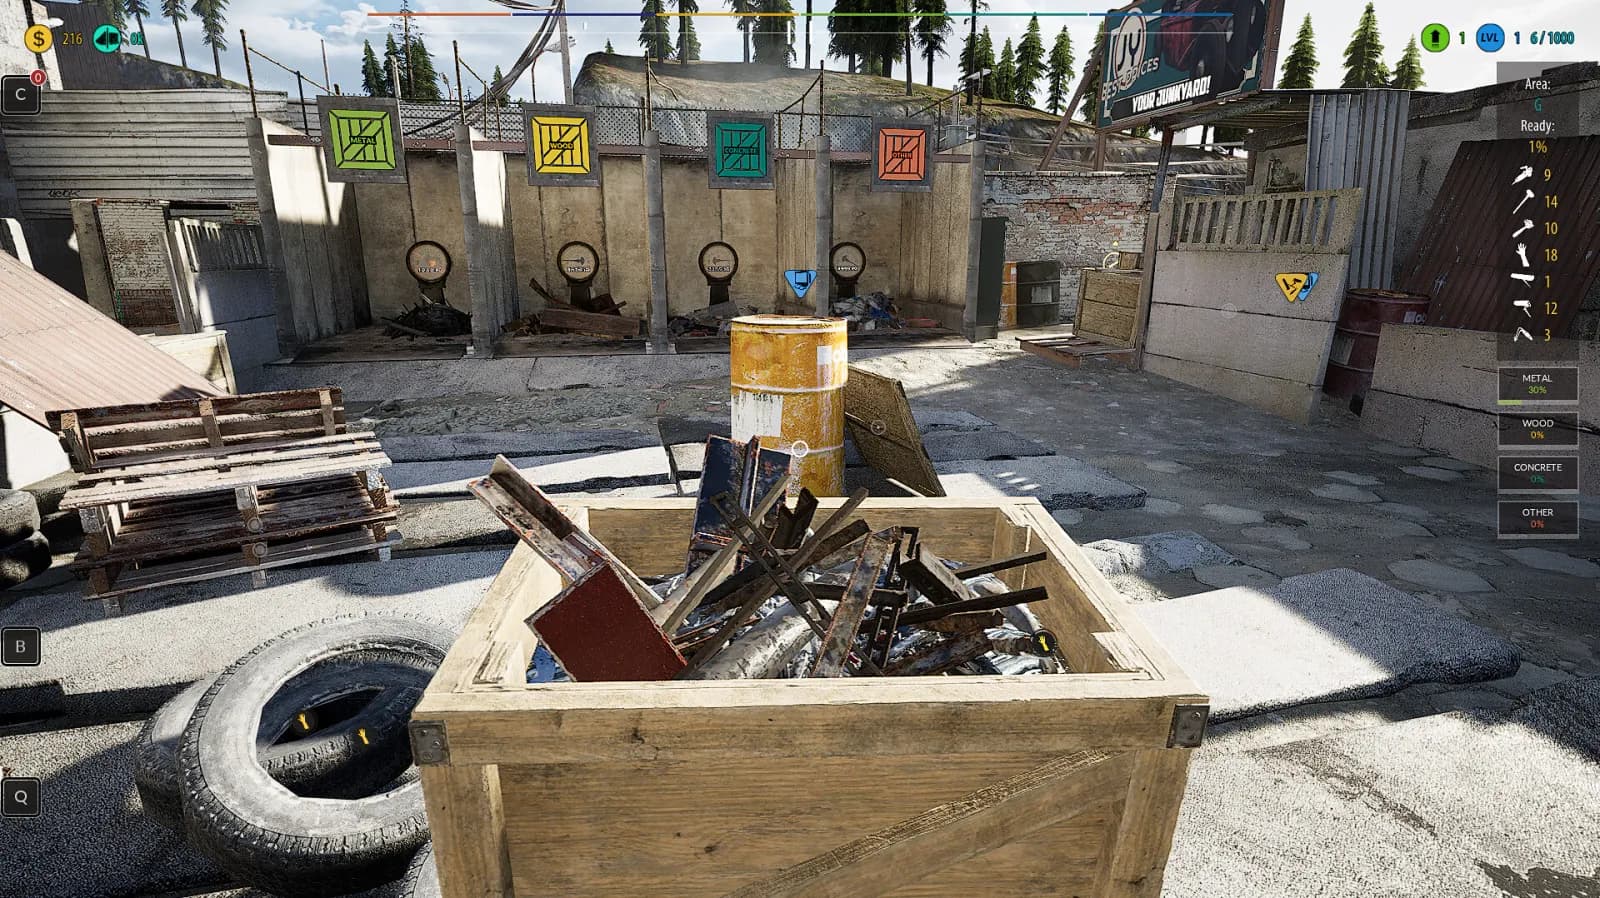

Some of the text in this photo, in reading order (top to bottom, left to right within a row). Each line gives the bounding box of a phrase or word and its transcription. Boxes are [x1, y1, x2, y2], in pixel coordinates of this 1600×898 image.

[1132, 75, 1212, 113] YOUR JUNKYARD!
[350, 136, 376, 144] METAL
[550, 142, 574, 150] WOOD
